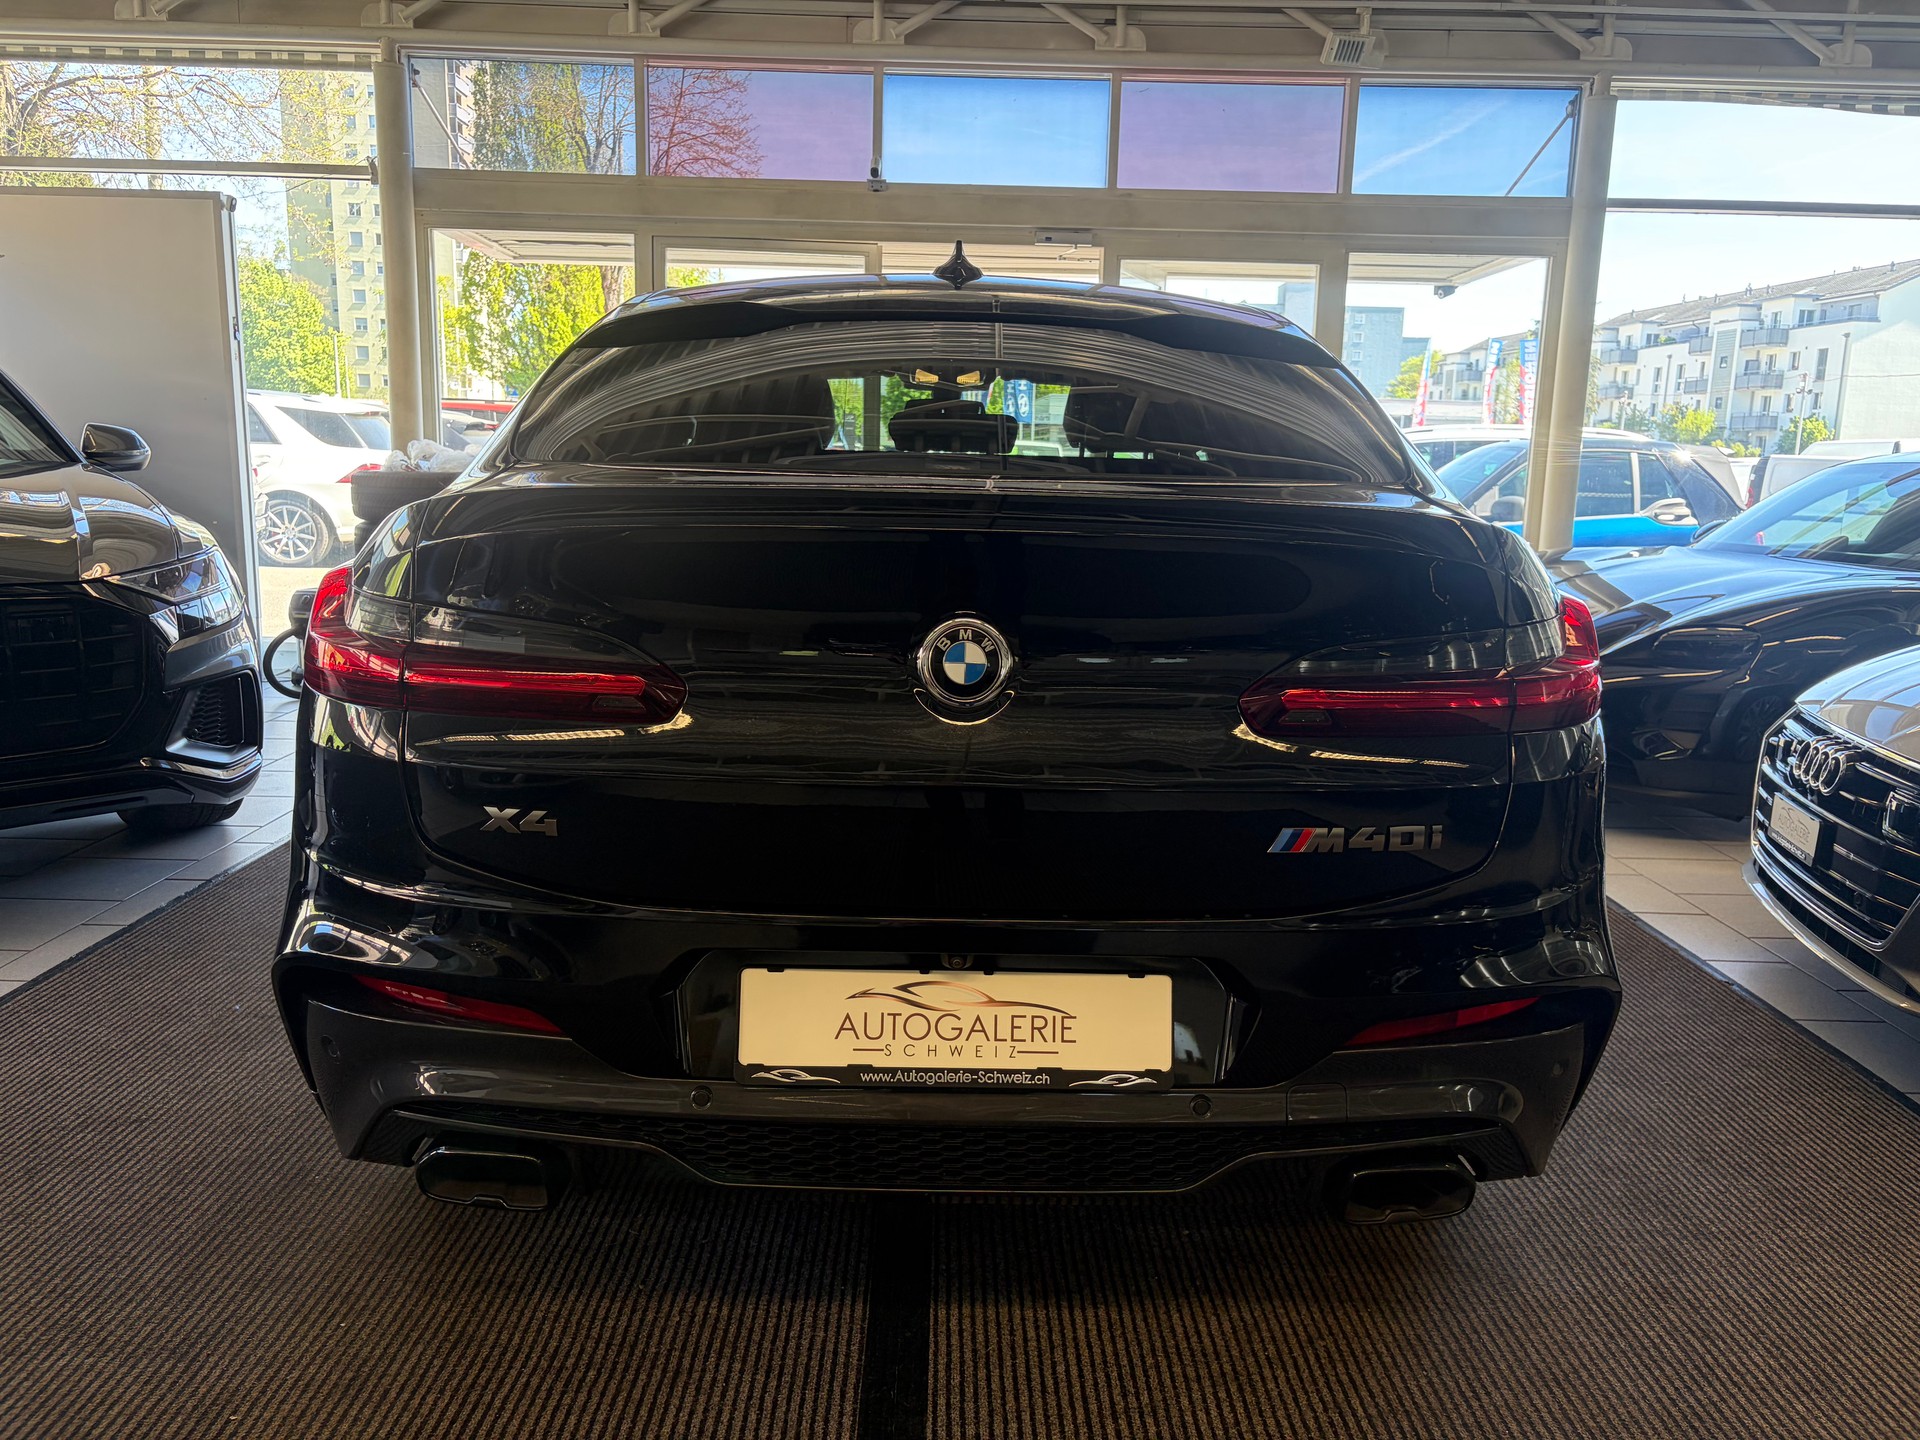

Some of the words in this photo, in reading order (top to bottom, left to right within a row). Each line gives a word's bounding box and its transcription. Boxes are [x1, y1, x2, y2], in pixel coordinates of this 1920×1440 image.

[937, 629, 996, 652] BMW
[480, 806, 558, 837] X4
[1301, 825, 1443, 853] M40i
[834, 1012, 1077, 1043] AUTOGALERIE
[884, 1043, 1017, 1059] SCHWEIZ
[860, 1069, 1050, 1085] www.Autogalerie-Schweiz.ch
